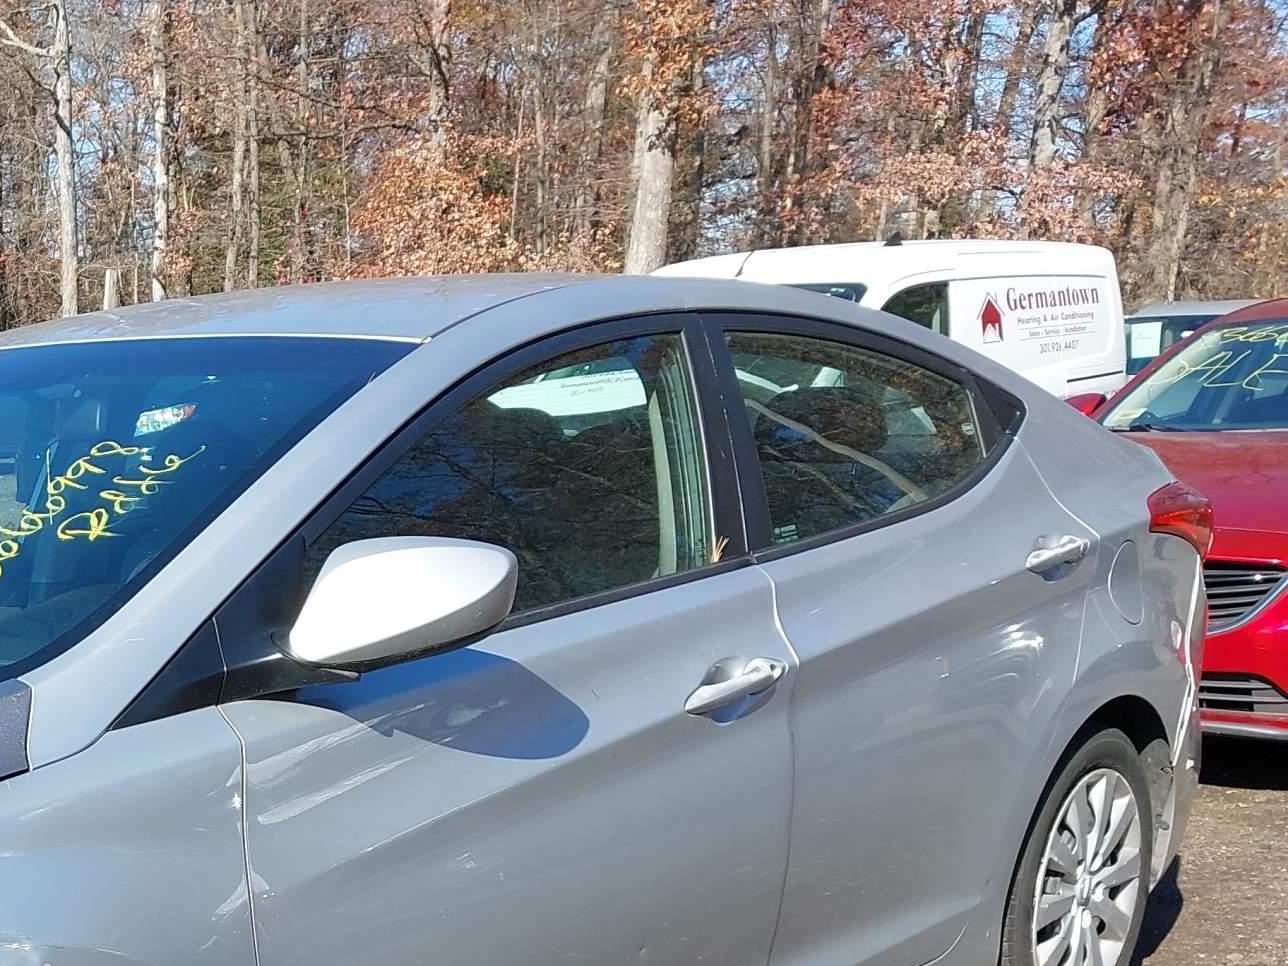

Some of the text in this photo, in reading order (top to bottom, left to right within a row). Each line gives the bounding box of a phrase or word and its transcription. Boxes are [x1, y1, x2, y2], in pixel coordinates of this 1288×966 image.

[1006, 286, 1100, 312] Germantown
[1017, 316, 1041, 325] Heating
[1050, 313, 1059, 321] Air
[1061, 312, 1095, 321] Conditioning
